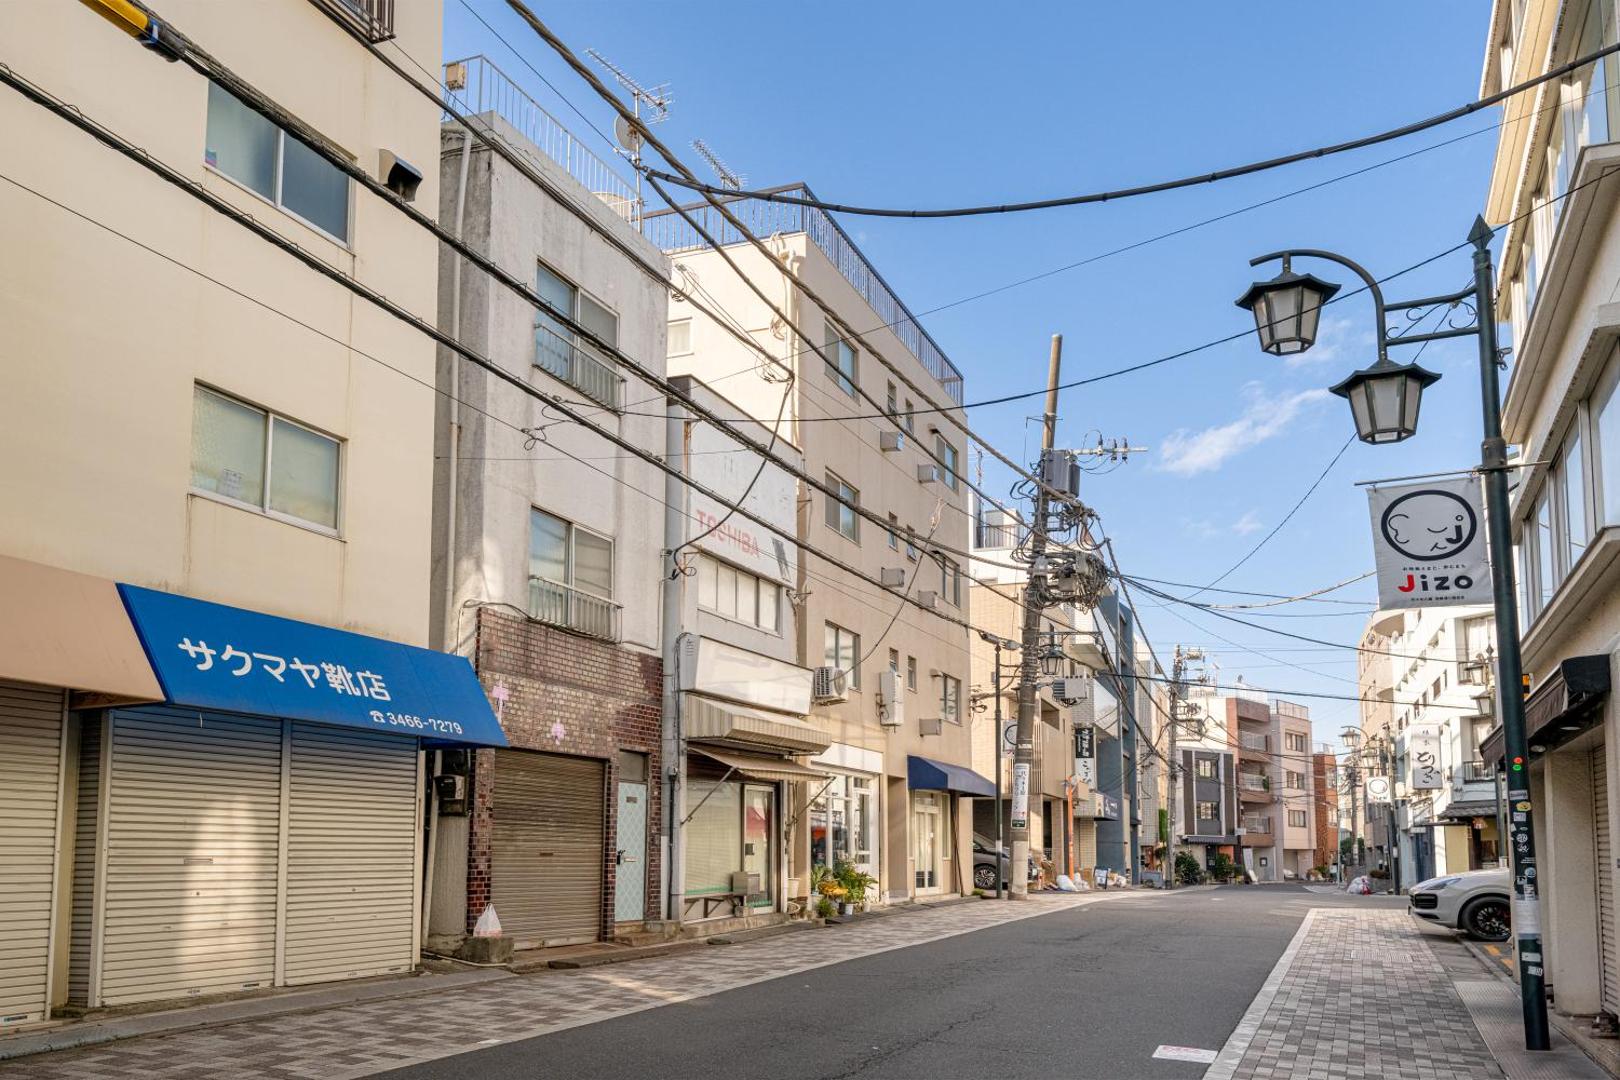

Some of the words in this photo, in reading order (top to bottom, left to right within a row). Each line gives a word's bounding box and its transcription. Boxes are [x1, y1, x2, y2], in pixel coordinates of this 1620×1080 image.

[696, 508, 760, 558] TOSHIBA
[1397, 573, 1474, 593] Jizo
[177, 637, 392, 701] サクマヤ靴店
[386, 711, 464, 735] 3466-7279
